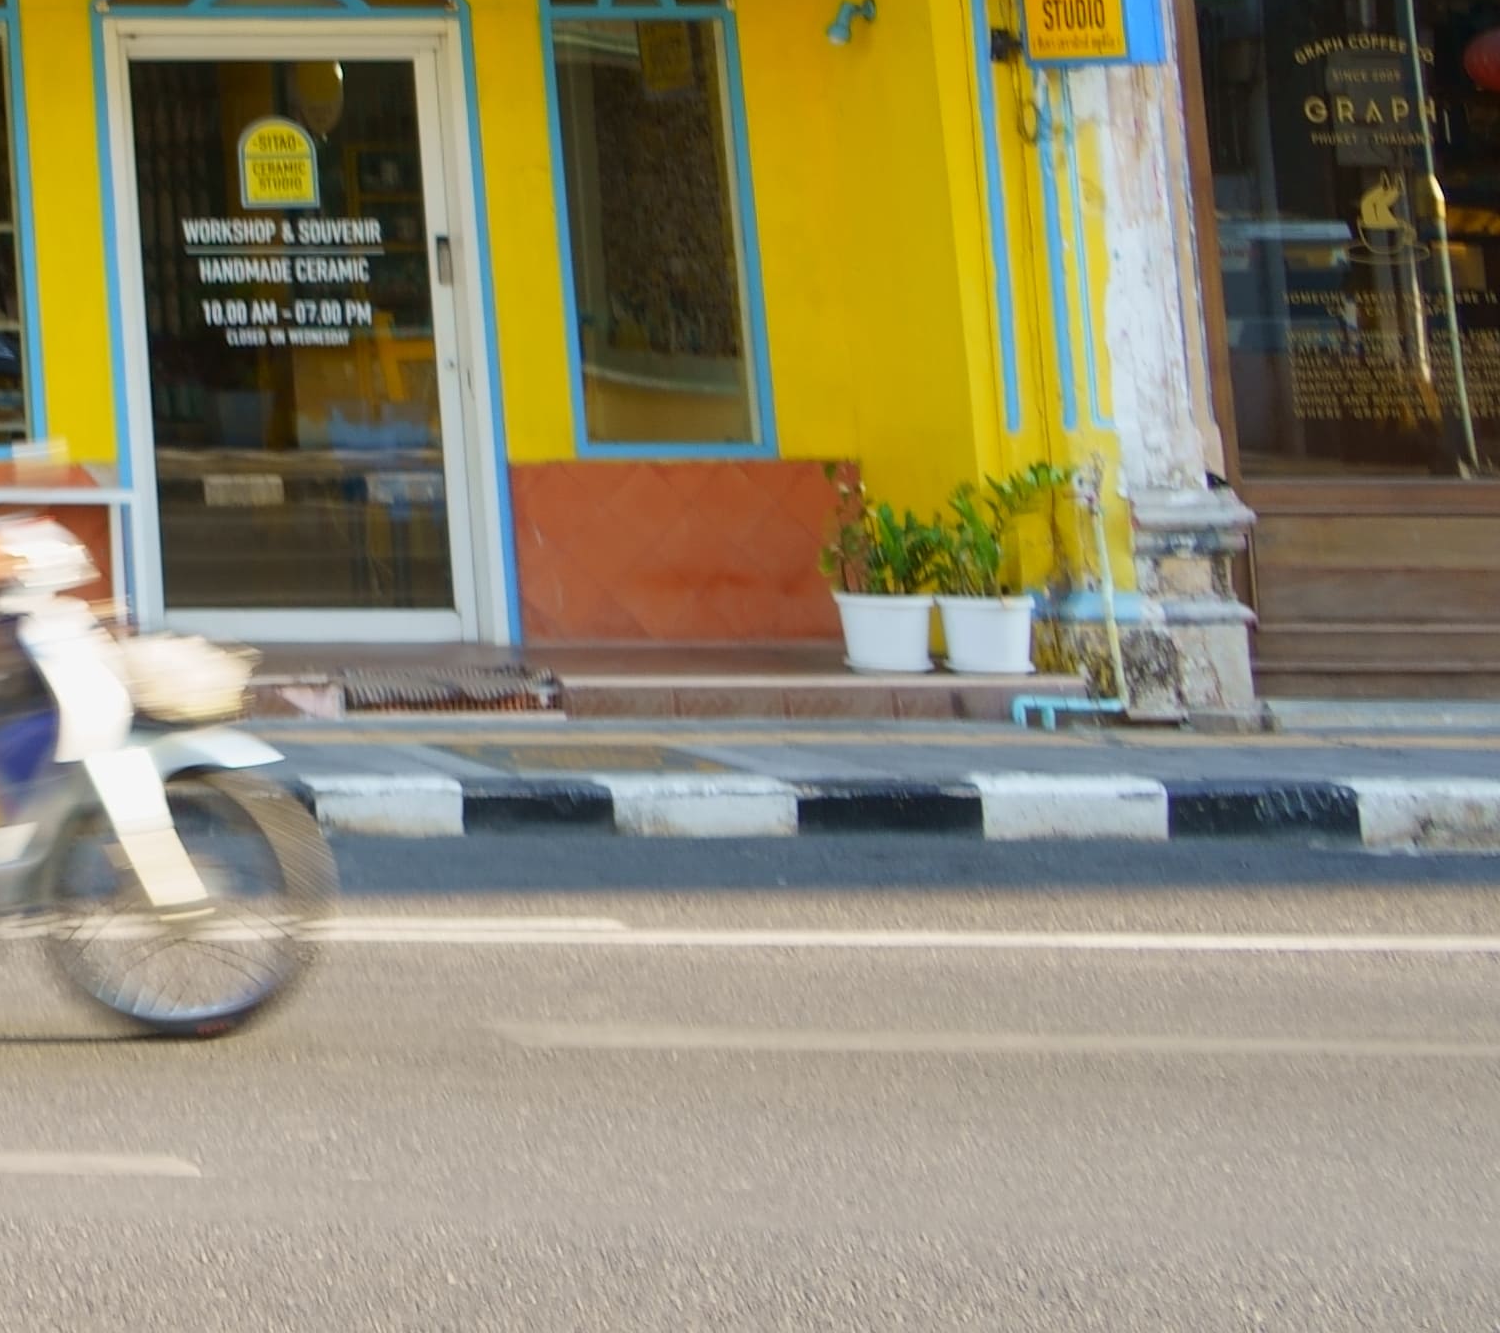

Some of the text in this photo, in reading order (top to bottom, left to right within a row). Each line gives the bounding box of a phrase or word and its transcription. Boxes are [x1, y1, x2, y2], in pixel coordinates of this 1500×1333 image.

[1294, 35, 1344, 65] GRAPH
[1348, 33, 1408, 54] COFFEE
[1304, 95, 1438, 124] GRAPH
[1311, 131, 1358, 146] PHUKET
[252, 162, 306, 177] CERAMIC
[258, 177, 303, 191] STUDIO
[182, 218, 382, 245] WORKSHOP & SOUVENIR
[199, 257, 370, 284] HANDMADE CERAMIC
[202, 300, 248, 326] 10.00
[251, 300, 278, 326] AM
[295, 300, 342, 326] 07.00
[346, 300, 373, 326] PM
[226, 329, 351, 347] CLOSED ON WEDNESDAY
